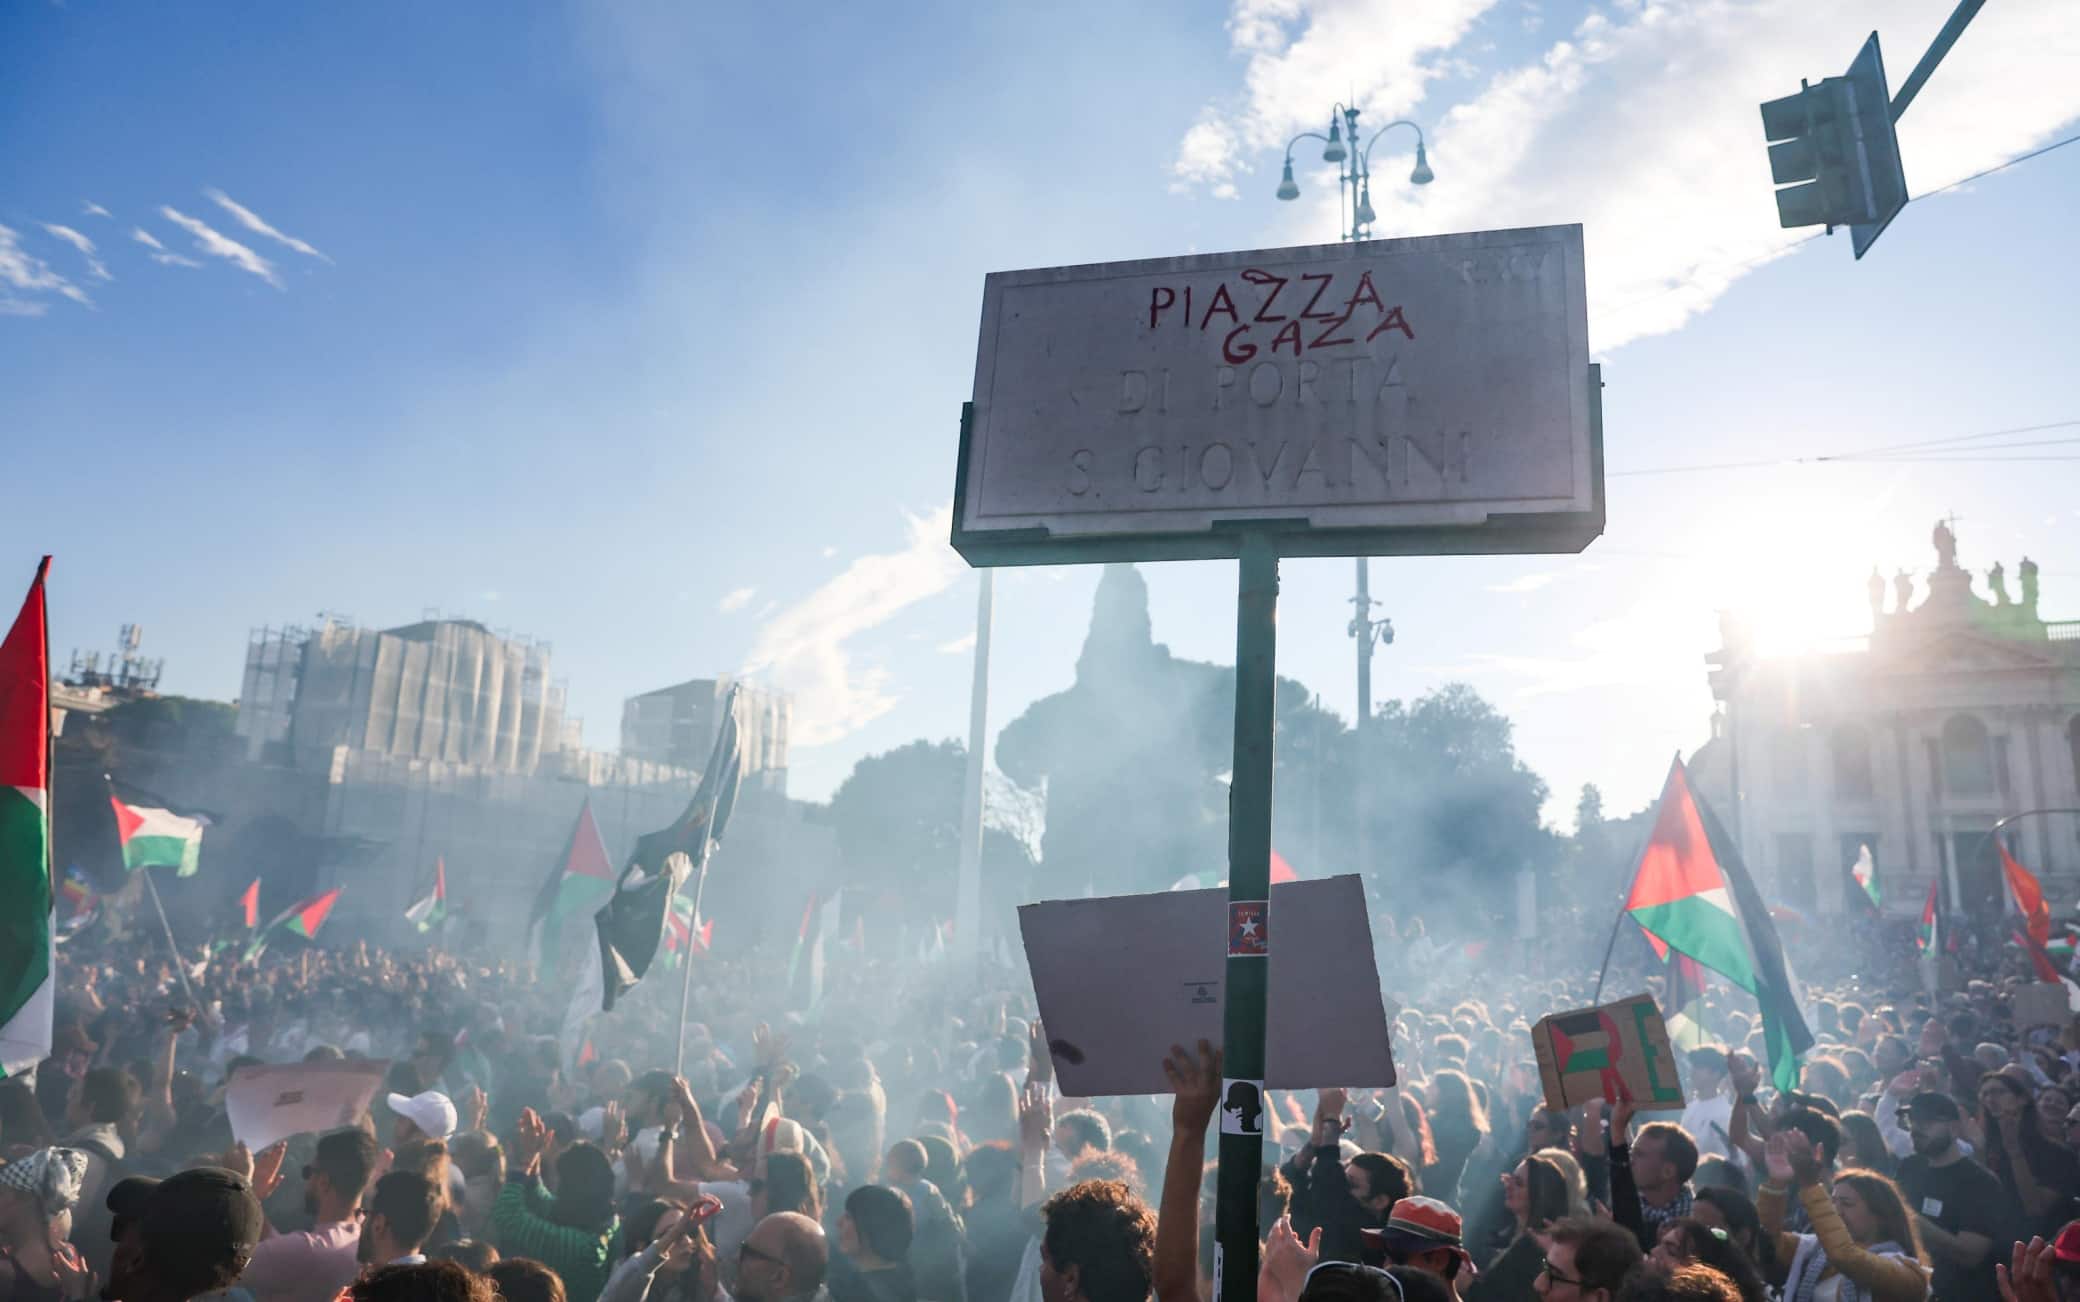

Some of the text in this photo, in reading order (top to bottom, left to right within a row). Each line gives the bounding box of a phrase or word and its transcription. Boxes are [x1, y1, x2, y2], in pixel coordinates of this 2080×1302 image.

[1149, 268, 1385, 331] PIAZZA
[1222, 305, 1415, 365] GAZA
[1118, 354, 1416, 416] DI PORTA
[1133, 431, 1472, 494] GIOVANNI
